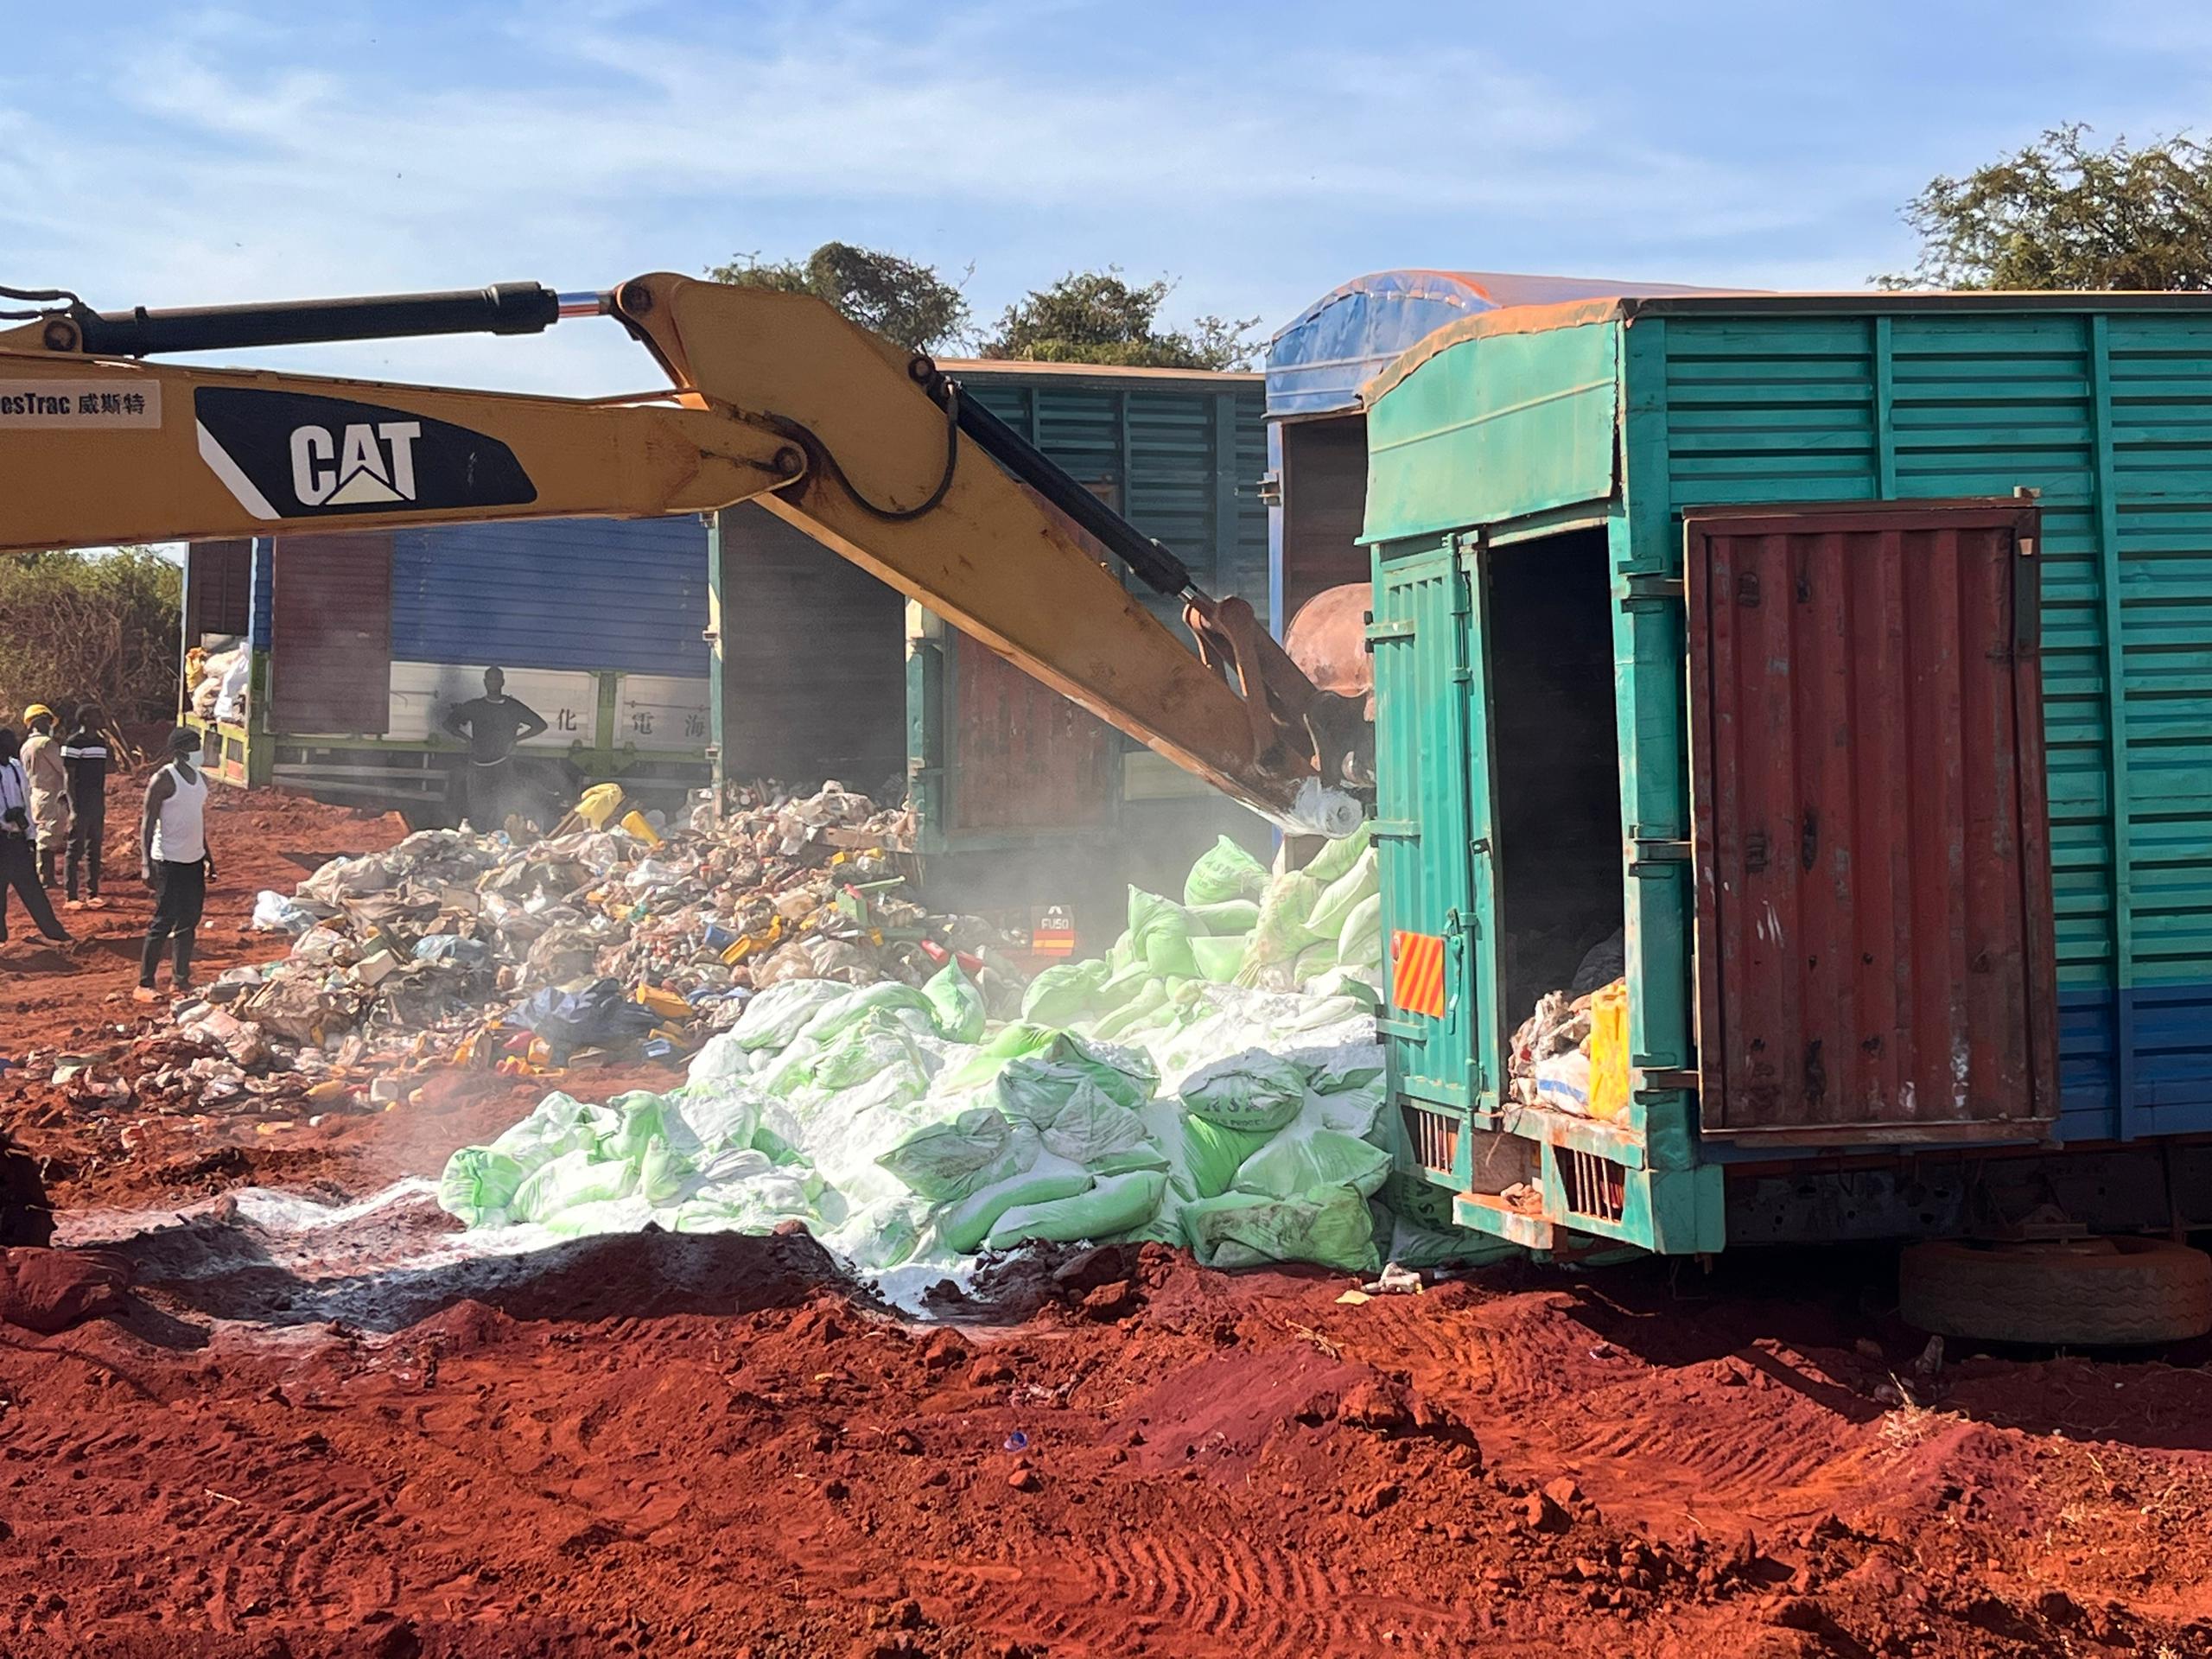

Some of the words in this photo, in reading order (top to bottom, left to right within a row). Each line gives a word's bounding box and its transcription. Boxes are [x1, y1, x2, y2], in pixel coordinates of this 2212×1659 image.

[79, 393, 146, 415] 威斯特
[289, 421, 422, 506] CAT
[1041, 918, 1070, 930] FUSO
